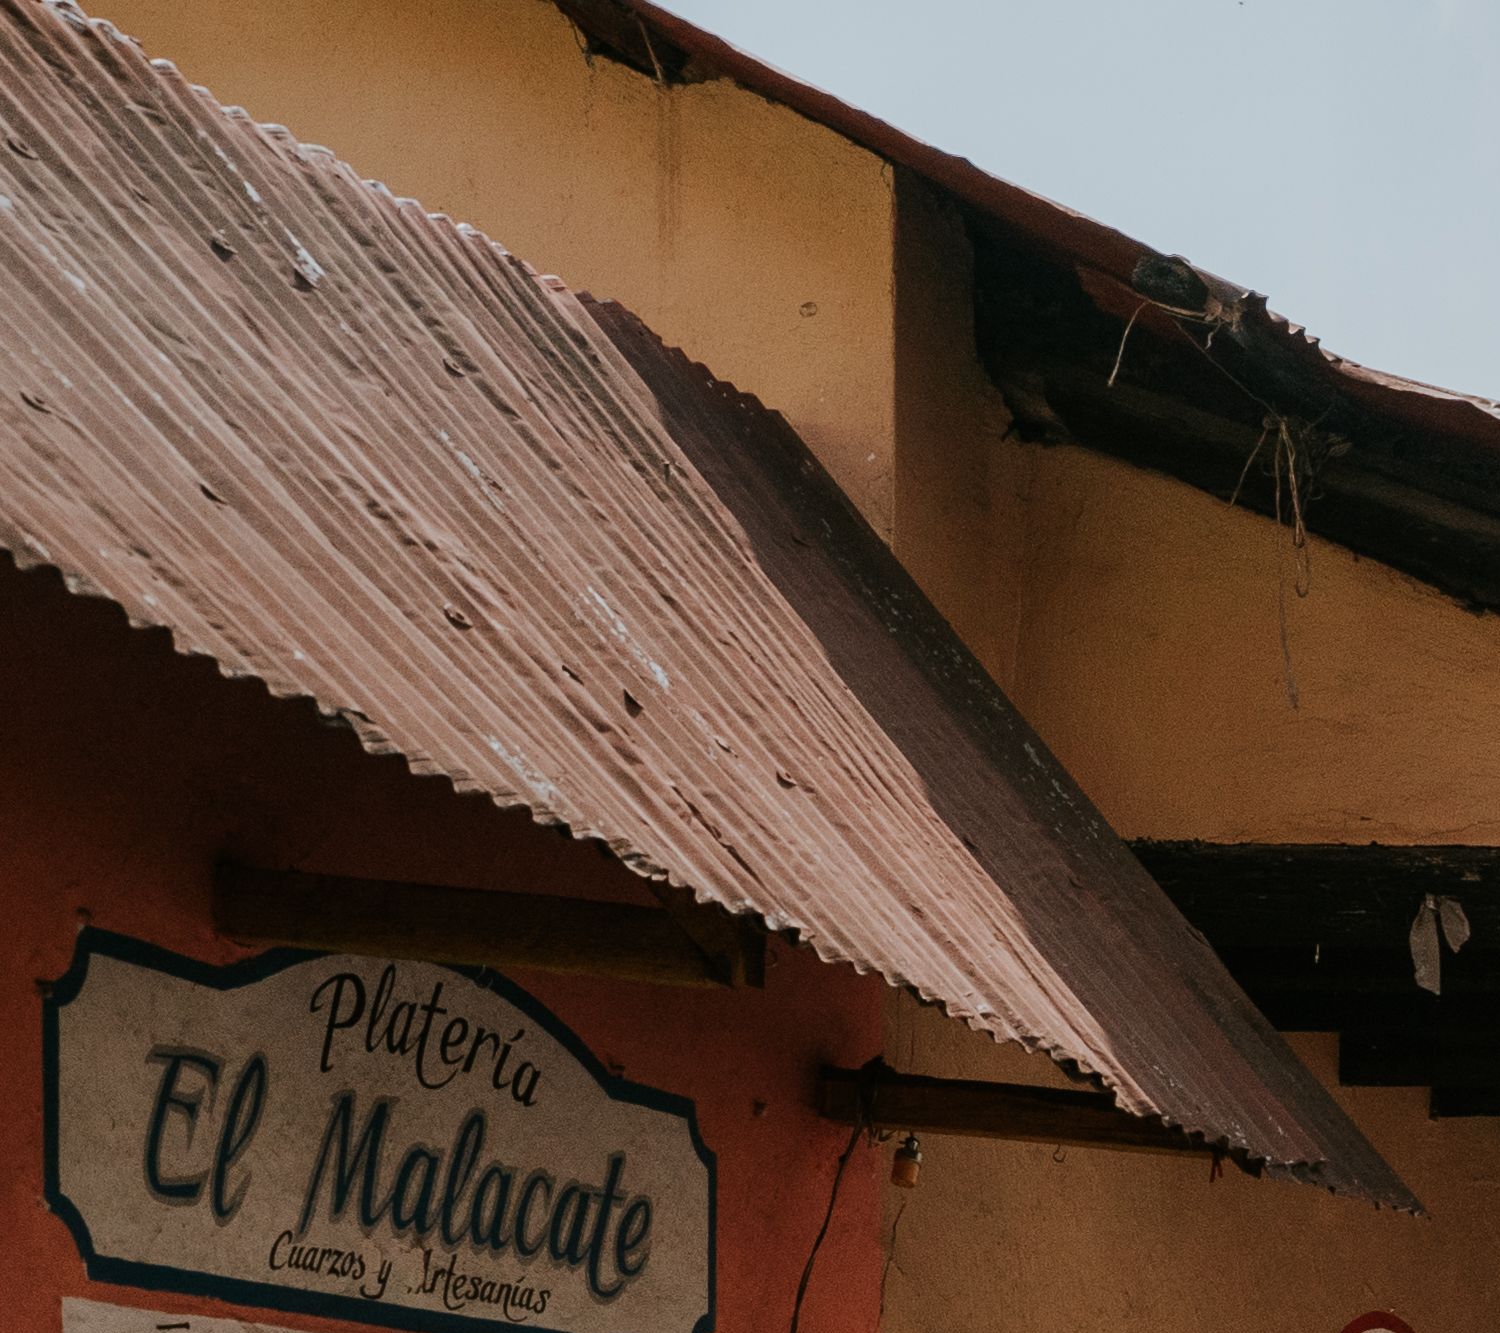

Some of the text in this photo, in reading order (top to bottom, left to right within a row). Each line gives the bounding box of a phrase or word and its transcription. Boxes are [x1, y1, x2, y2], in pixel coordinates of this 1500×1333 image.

[311, 964, 541, 1107] Platería
[143, 1044, 655, 1300] El Malacate
[269, 1230, 366, 1281] Cuarzos
[360, 1260, 392, 1300] y
